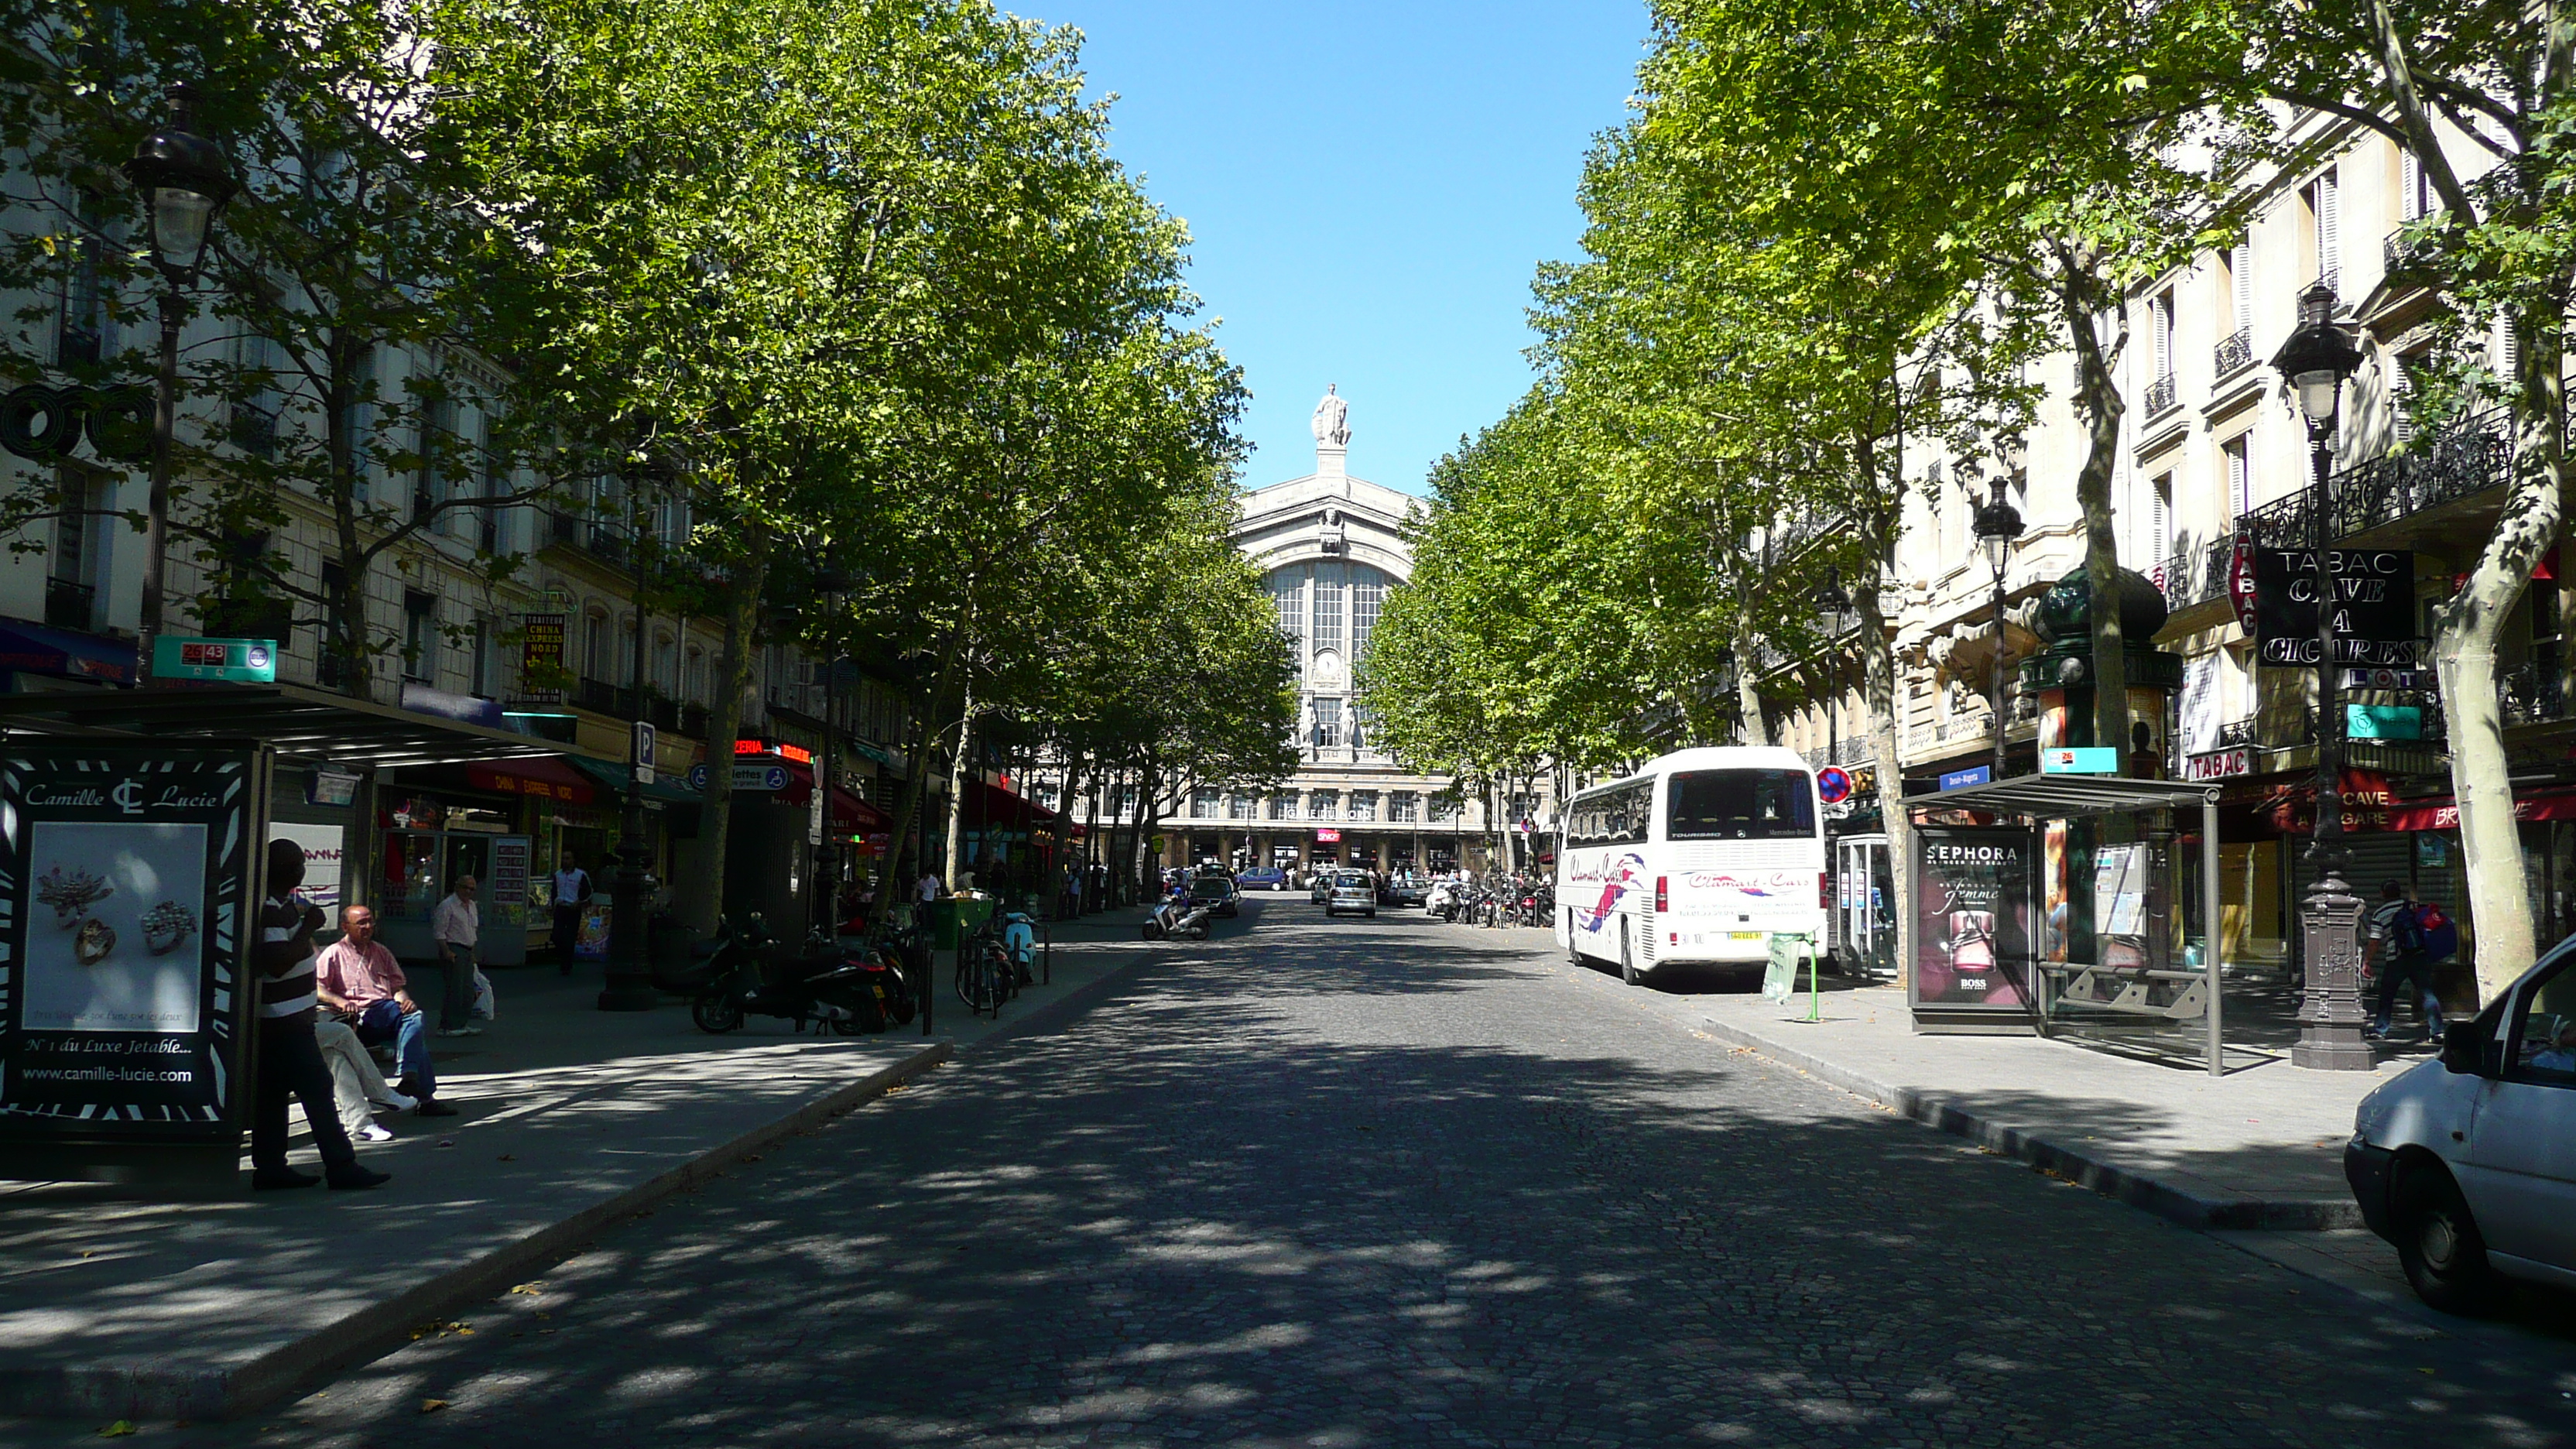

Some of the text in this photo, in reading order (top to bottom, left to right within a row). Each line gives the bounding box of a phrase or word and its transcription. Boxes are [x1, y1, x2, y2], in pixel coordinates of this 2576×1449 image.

[2276, 552, 2398, 574] TABAC
[2238, 543, 2256, 629] TABAC
[2289, 578, 2386, 603] CAVE
[527, 615, 564, 625] TRAITEUR
[529, 625, 560, 634] CHINA
[526, 635, 564, 643] EXPRESS
[185, 646, 269, 662] 26 43 BUS
[530, 644, 559, 653] NORD
[0, 652, 60, 668] OPTIQUE
[84, 660, 124, 679] OPTIQUE
[642, 731, 650, 758] P
[735, 739, 762, 754] ZERIA
[2062, 752, 2073, 760] 26
[2194, 750, 2245, 779] TABAC
[732, 769, 761, 779] lettes
[496, 775, 573, 800] CHINA EXPRESS NORD
[26, 784, 104, 807] Camille
[151, 785, 218, 807] Lucie
[2342, 791, 2389, 806] CAVE
[1287, 808, 1371, 820] GARE DU NORD
[2341, 814, 2389, 827] GARE
[1318, 833, 1341, 841] SNCF
[1769, 828, 1811, 838] Mercedes-Benz
[1927, 845, 2017, 860] SEPHORA
[1689, 872, 1759, 888] Clamart
[1770, 872, 1809, 887] Cars
[1932, 878, 1999, 915] femme
[1961, 978, 1987, 987] BOSS
[60, 1038, 80, 1053] du
[83, 1039, 122, 1053] Luxe
[123, 1038, 192, 1055] Jetable...
[23, 1067, 193, 1084] www.camille-lucie.com
